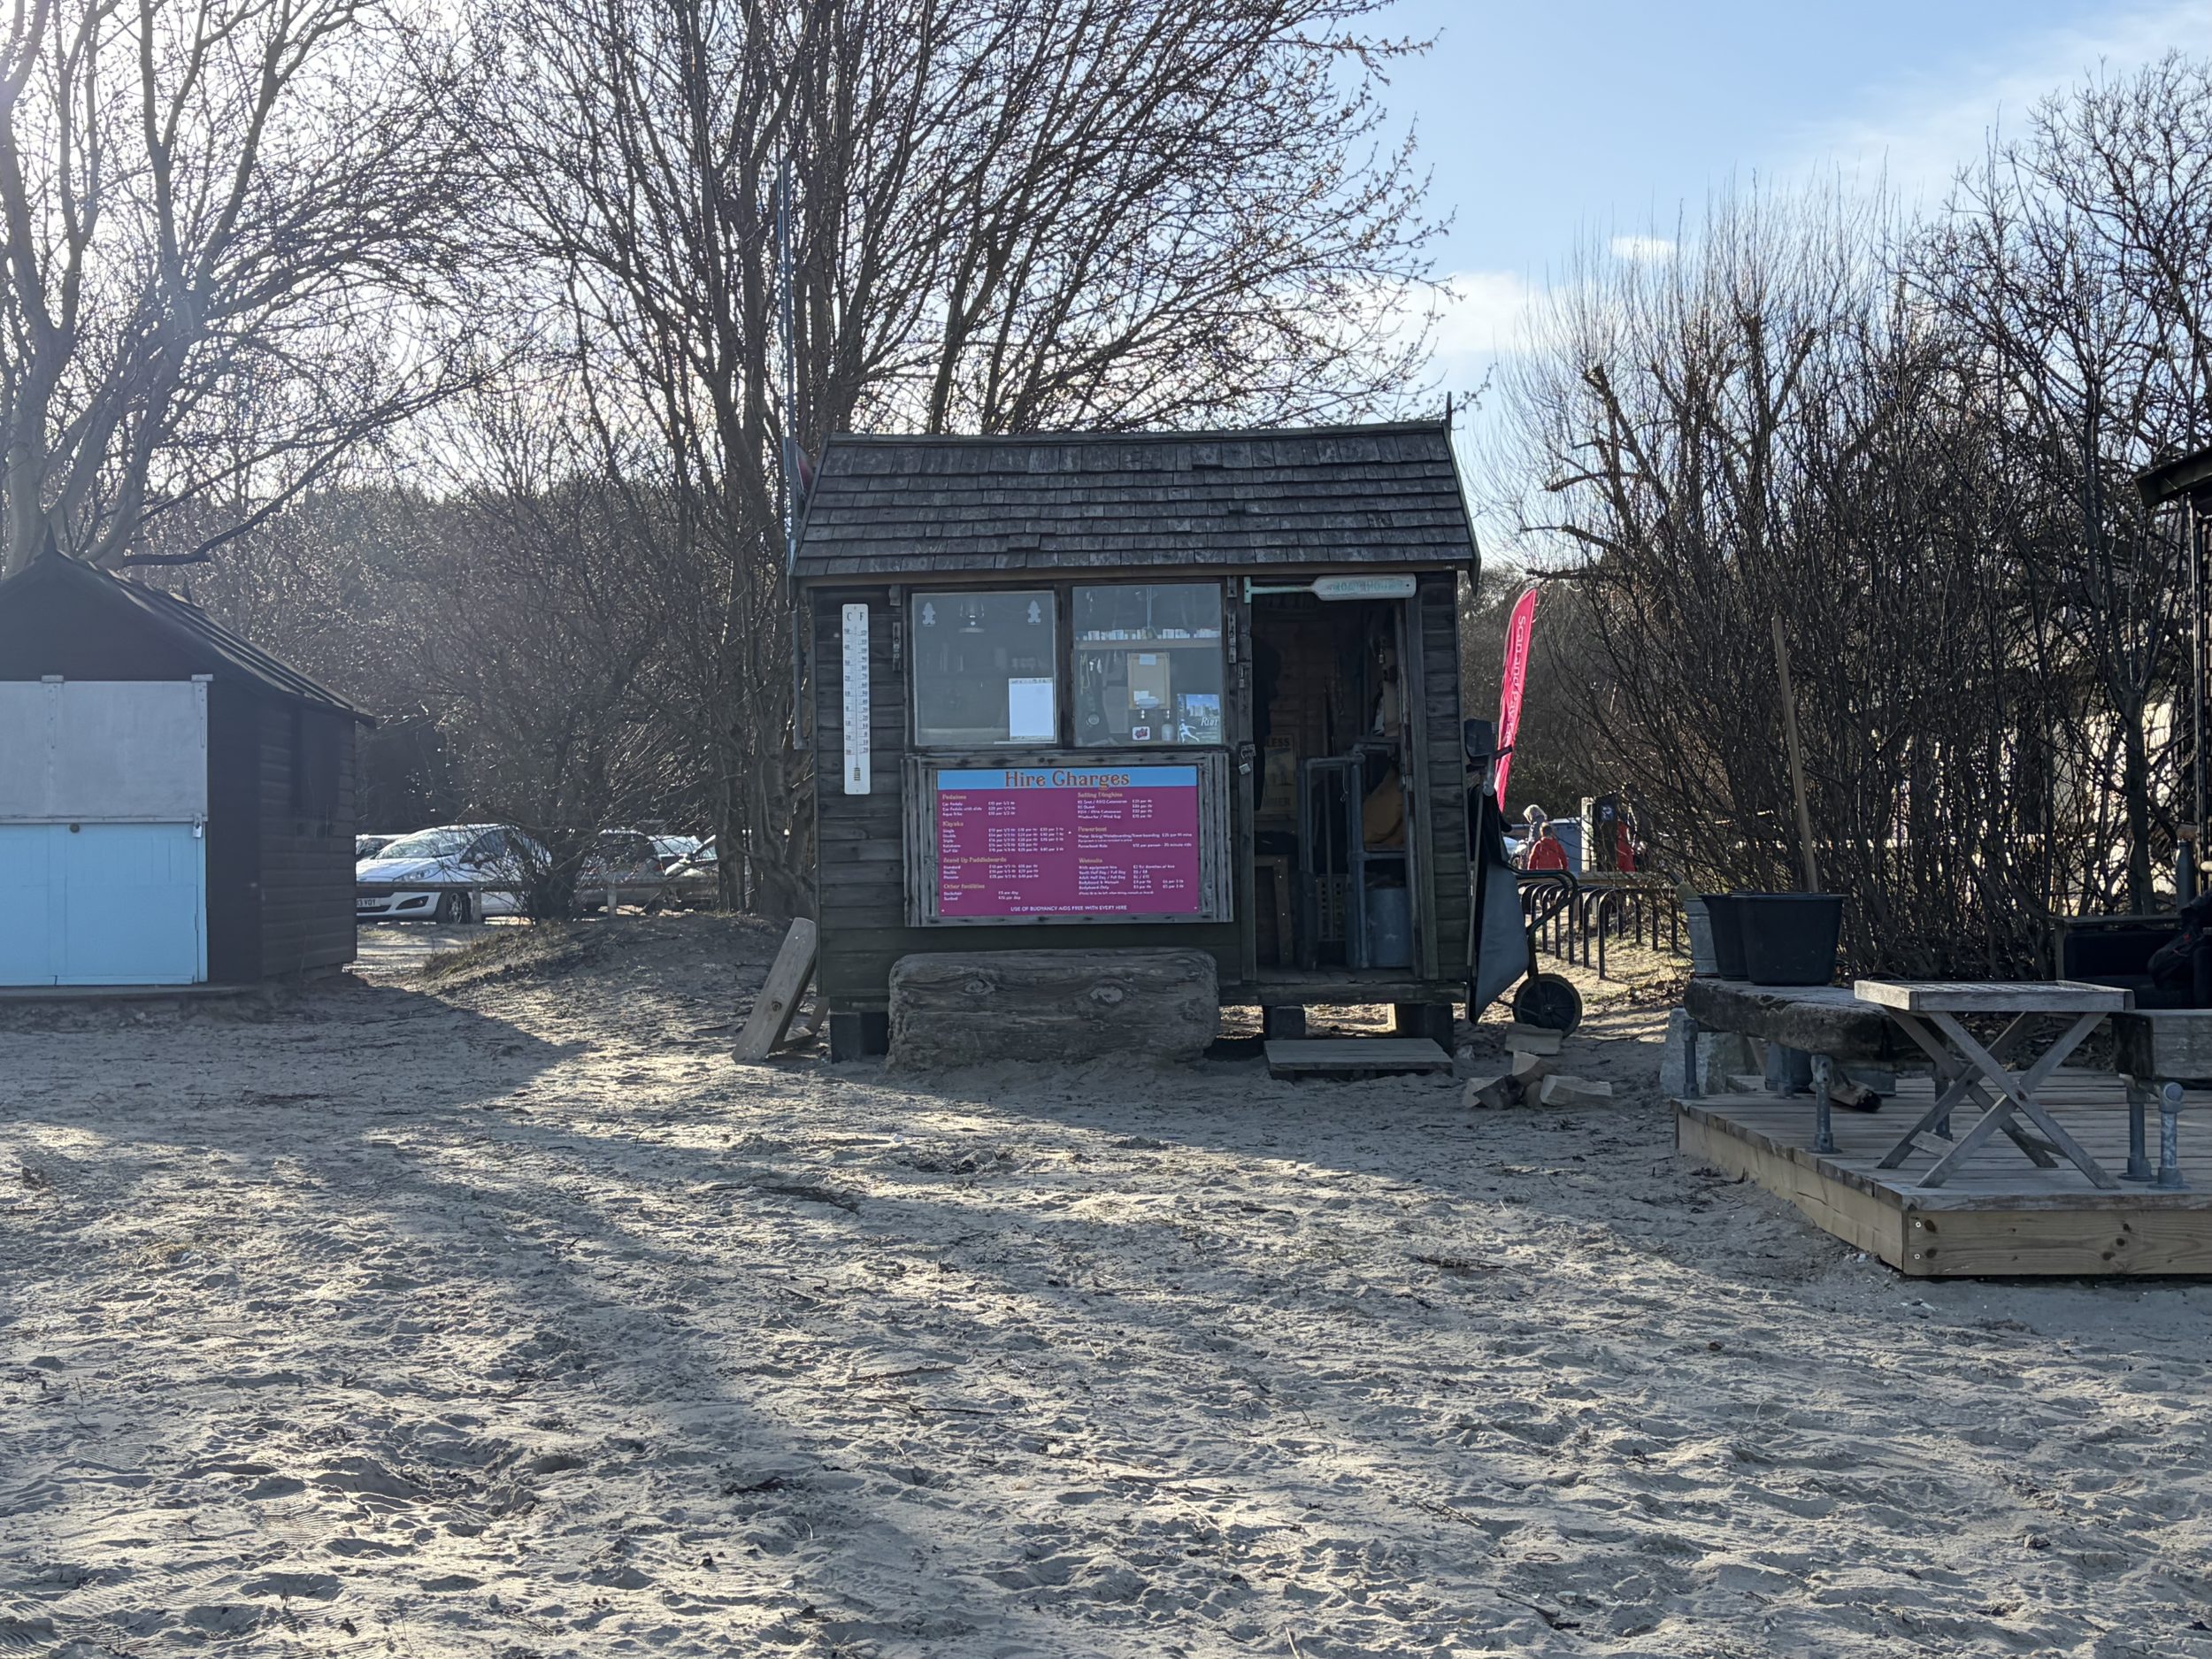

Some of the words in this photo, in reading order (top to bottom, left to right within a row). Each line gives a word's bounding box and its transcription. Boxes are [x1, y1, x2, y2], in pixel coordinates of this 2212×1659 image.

[847, 612, 853, 622] C
[860, 611, 865, 622] F
[1515, 615, 1526, 653] Scan
[1512, 655, 1521, 687] and
[1005, 771, 1046, 787] Hire
[1052, 770, 1130, 790] Charges
